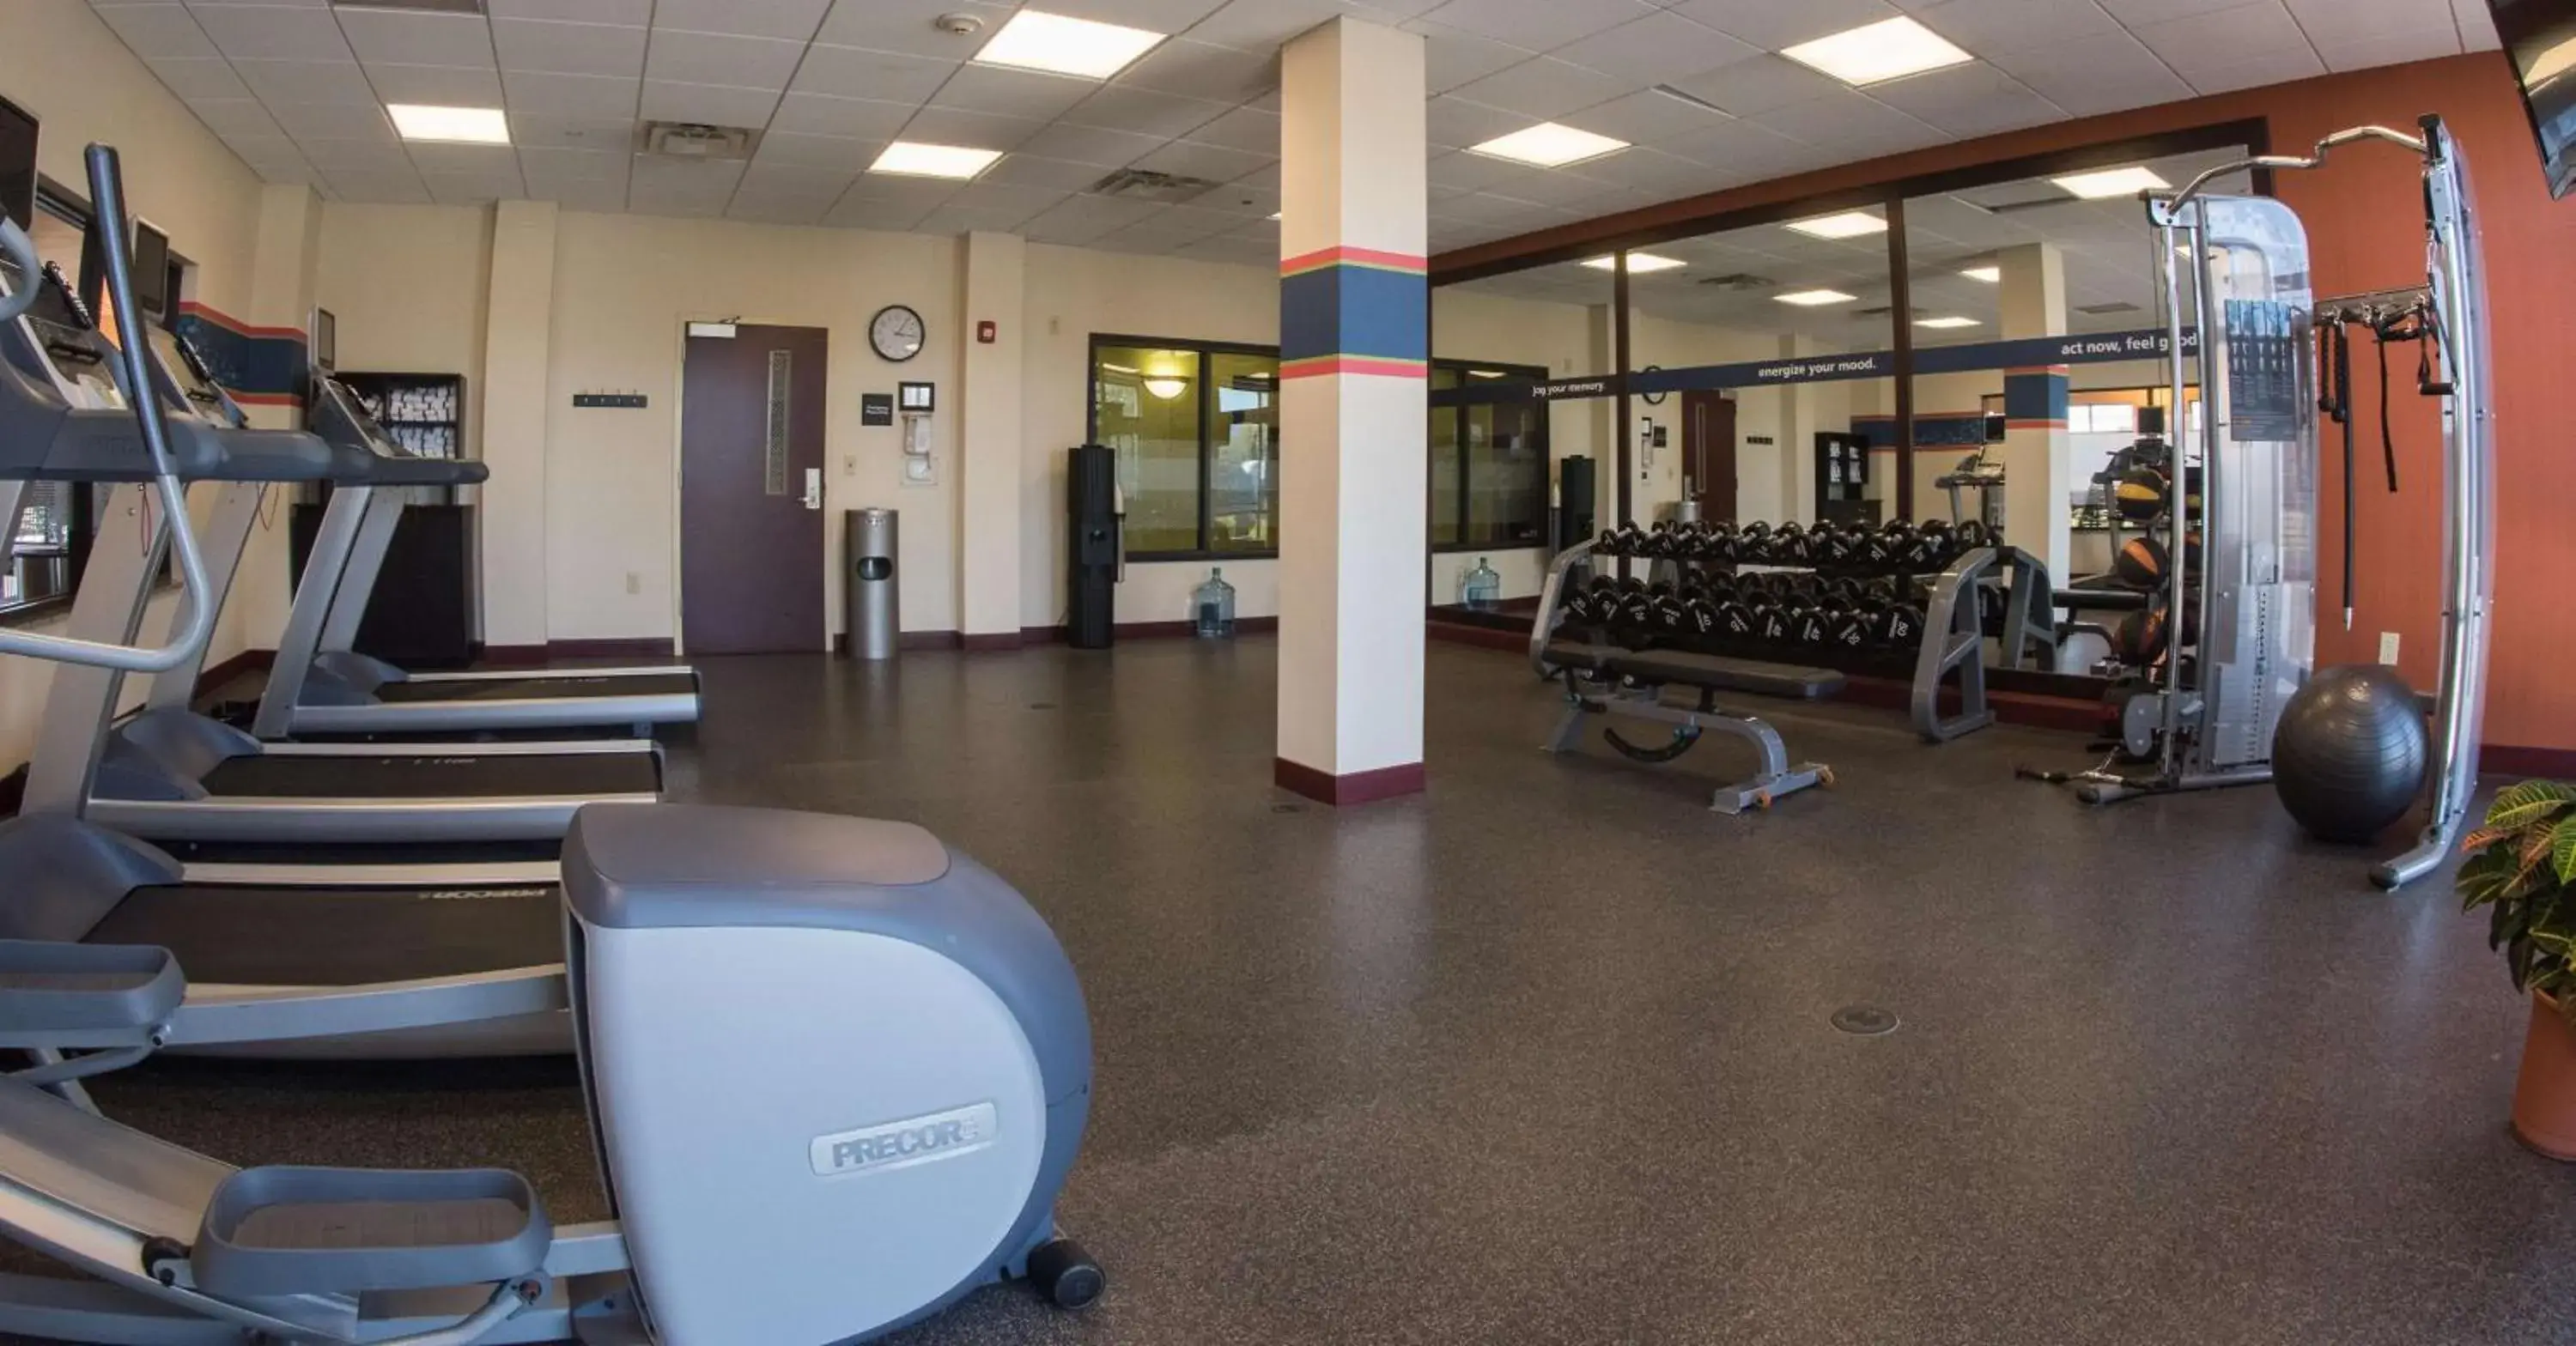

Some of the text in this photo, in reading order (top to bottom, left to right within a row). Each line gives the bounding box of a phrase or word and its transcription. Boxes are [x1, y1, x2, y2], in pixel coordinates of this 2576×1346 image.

[2061, 332, 2198, 355] act now, feel god
[1759, 356, 1876, 379] energize your mood.
[1547, 384, 1567, 396] your
[832, 1119, 963, 1167] PRECOR
